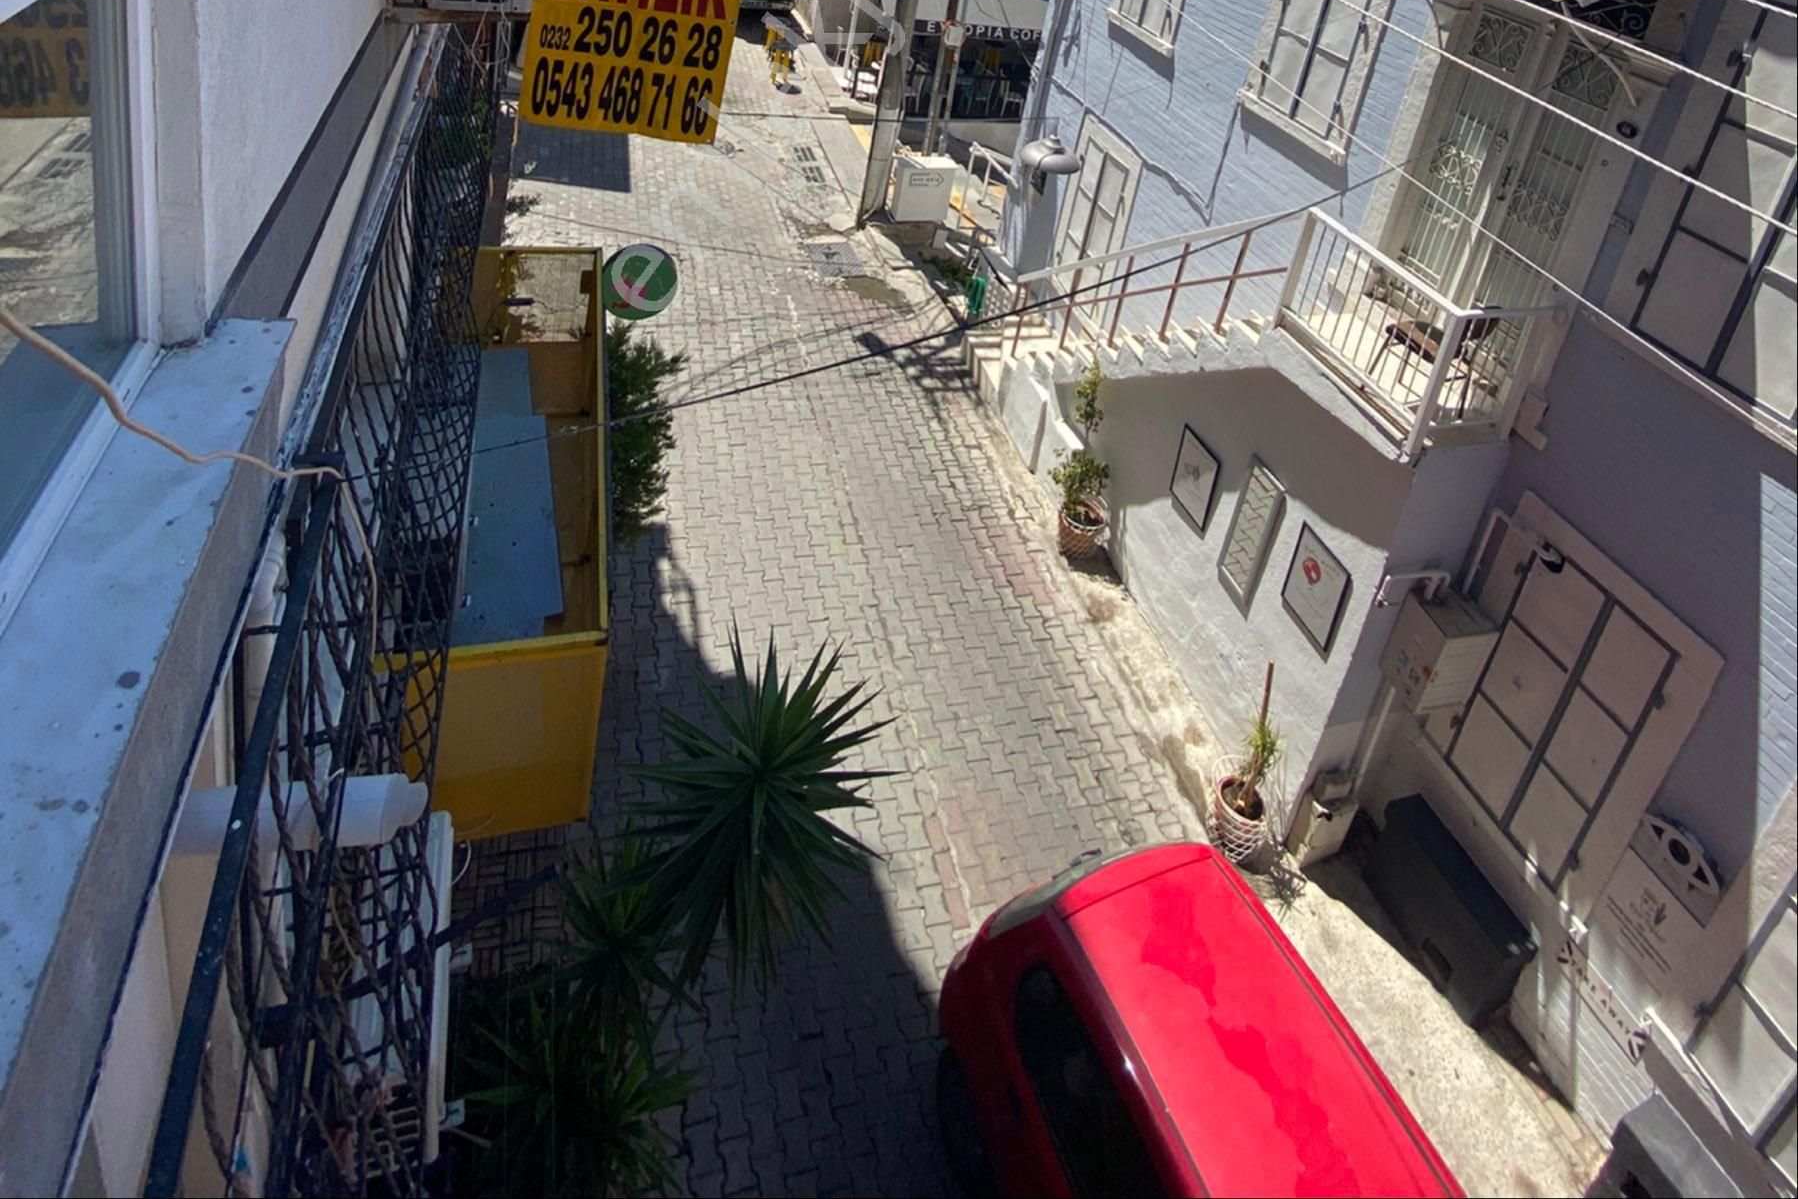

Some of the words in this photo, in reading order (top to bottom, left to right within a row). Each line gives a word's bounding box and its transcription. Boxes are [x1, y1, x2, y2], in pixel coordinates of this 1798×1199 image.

[540, 24, 571, 50] 0232
[573, 6, 633, 57] 250
[639, 16, 678, 65] 26
[683, 23, 723, 72] 28
[531, 57, 594, 121] 0543
[598, 65, 644, 125] 468
[647, 73, 677, 130] 71
[680, 76, 713, 136] 66
